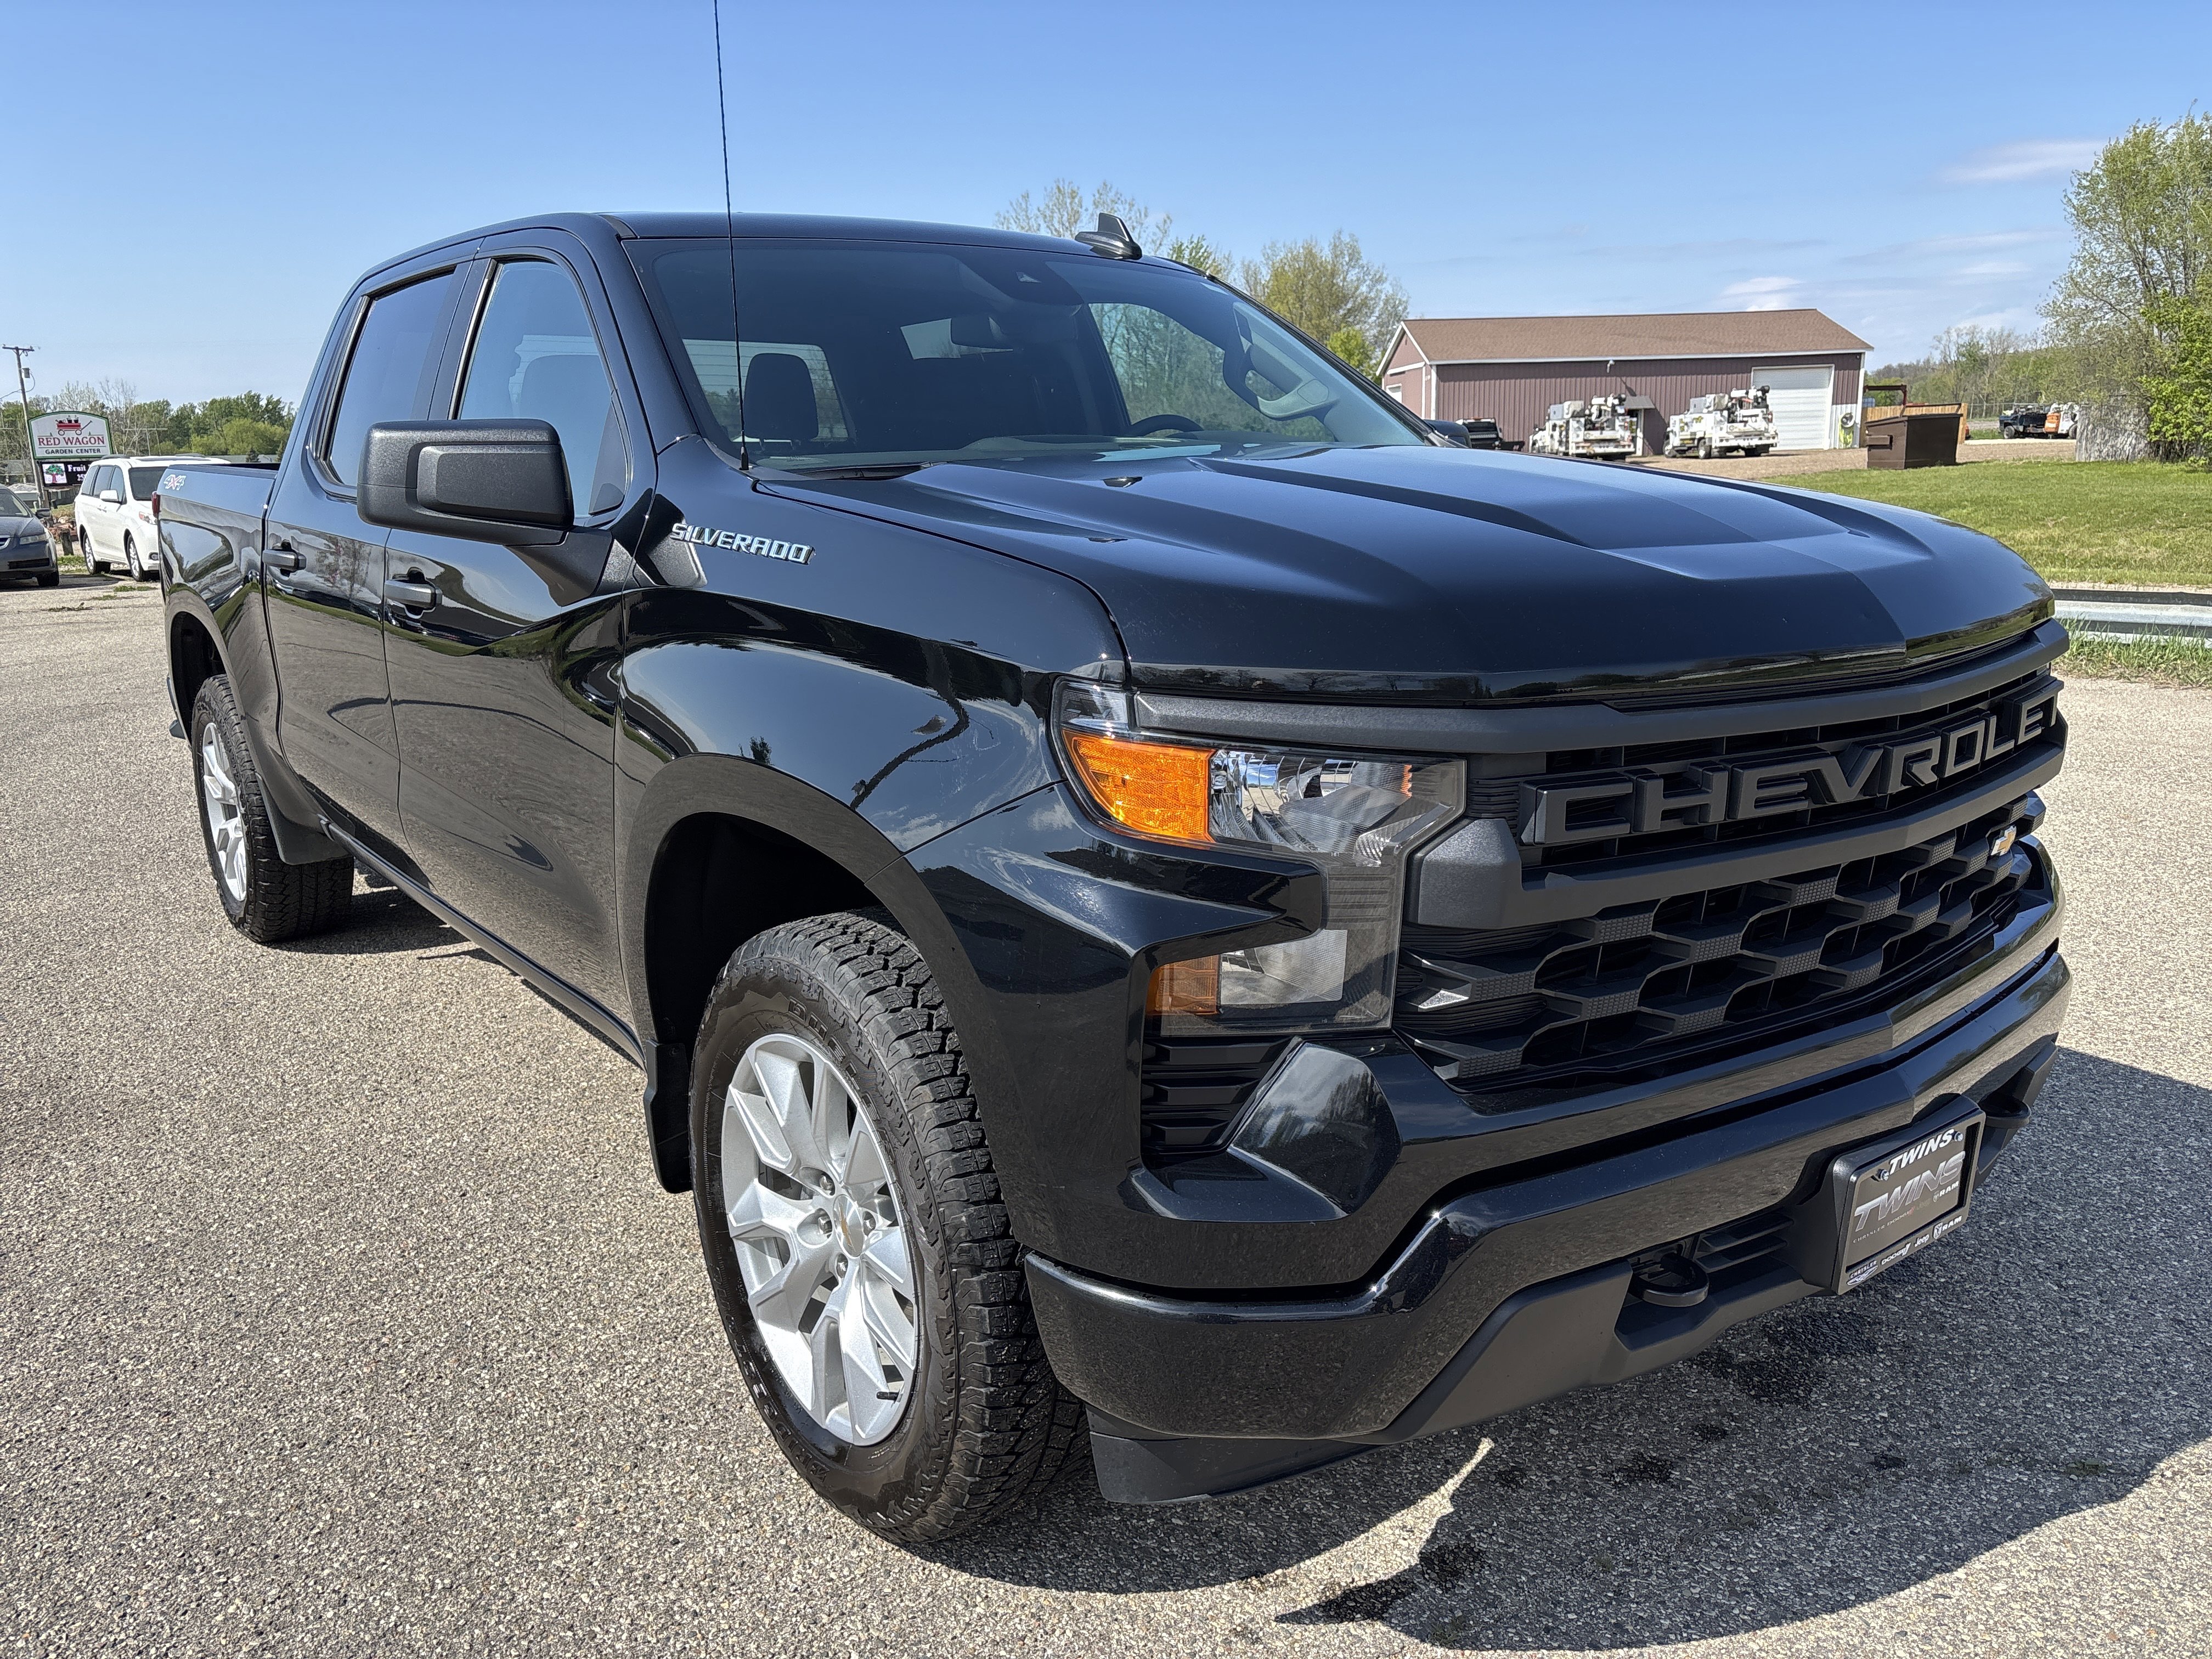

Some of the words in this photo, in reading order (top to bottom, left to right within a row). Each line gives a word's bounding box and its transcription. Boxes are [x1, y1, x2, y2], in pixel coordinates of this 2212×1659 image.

[37, 437, 60, 446] RED
[63, 436, 105, 445] WAGON
[67, 464, 87, 472] Fruit
[670, 523, 815, 565] SILVERADO
[1519, 679, 2064, 845] CHEVROLET
[1889, 1128, 1955, 1175] TWINS
[1854, 1150, 1966, 1232] TWINS
[1939, 1180, 1959, 1197] RAM
[1850, 1260, 1877, 1279] CHRYSLER
[1914, 1234, 1929, 1247] Jeep
[1942, 1215, 1962, 1232] RAM
